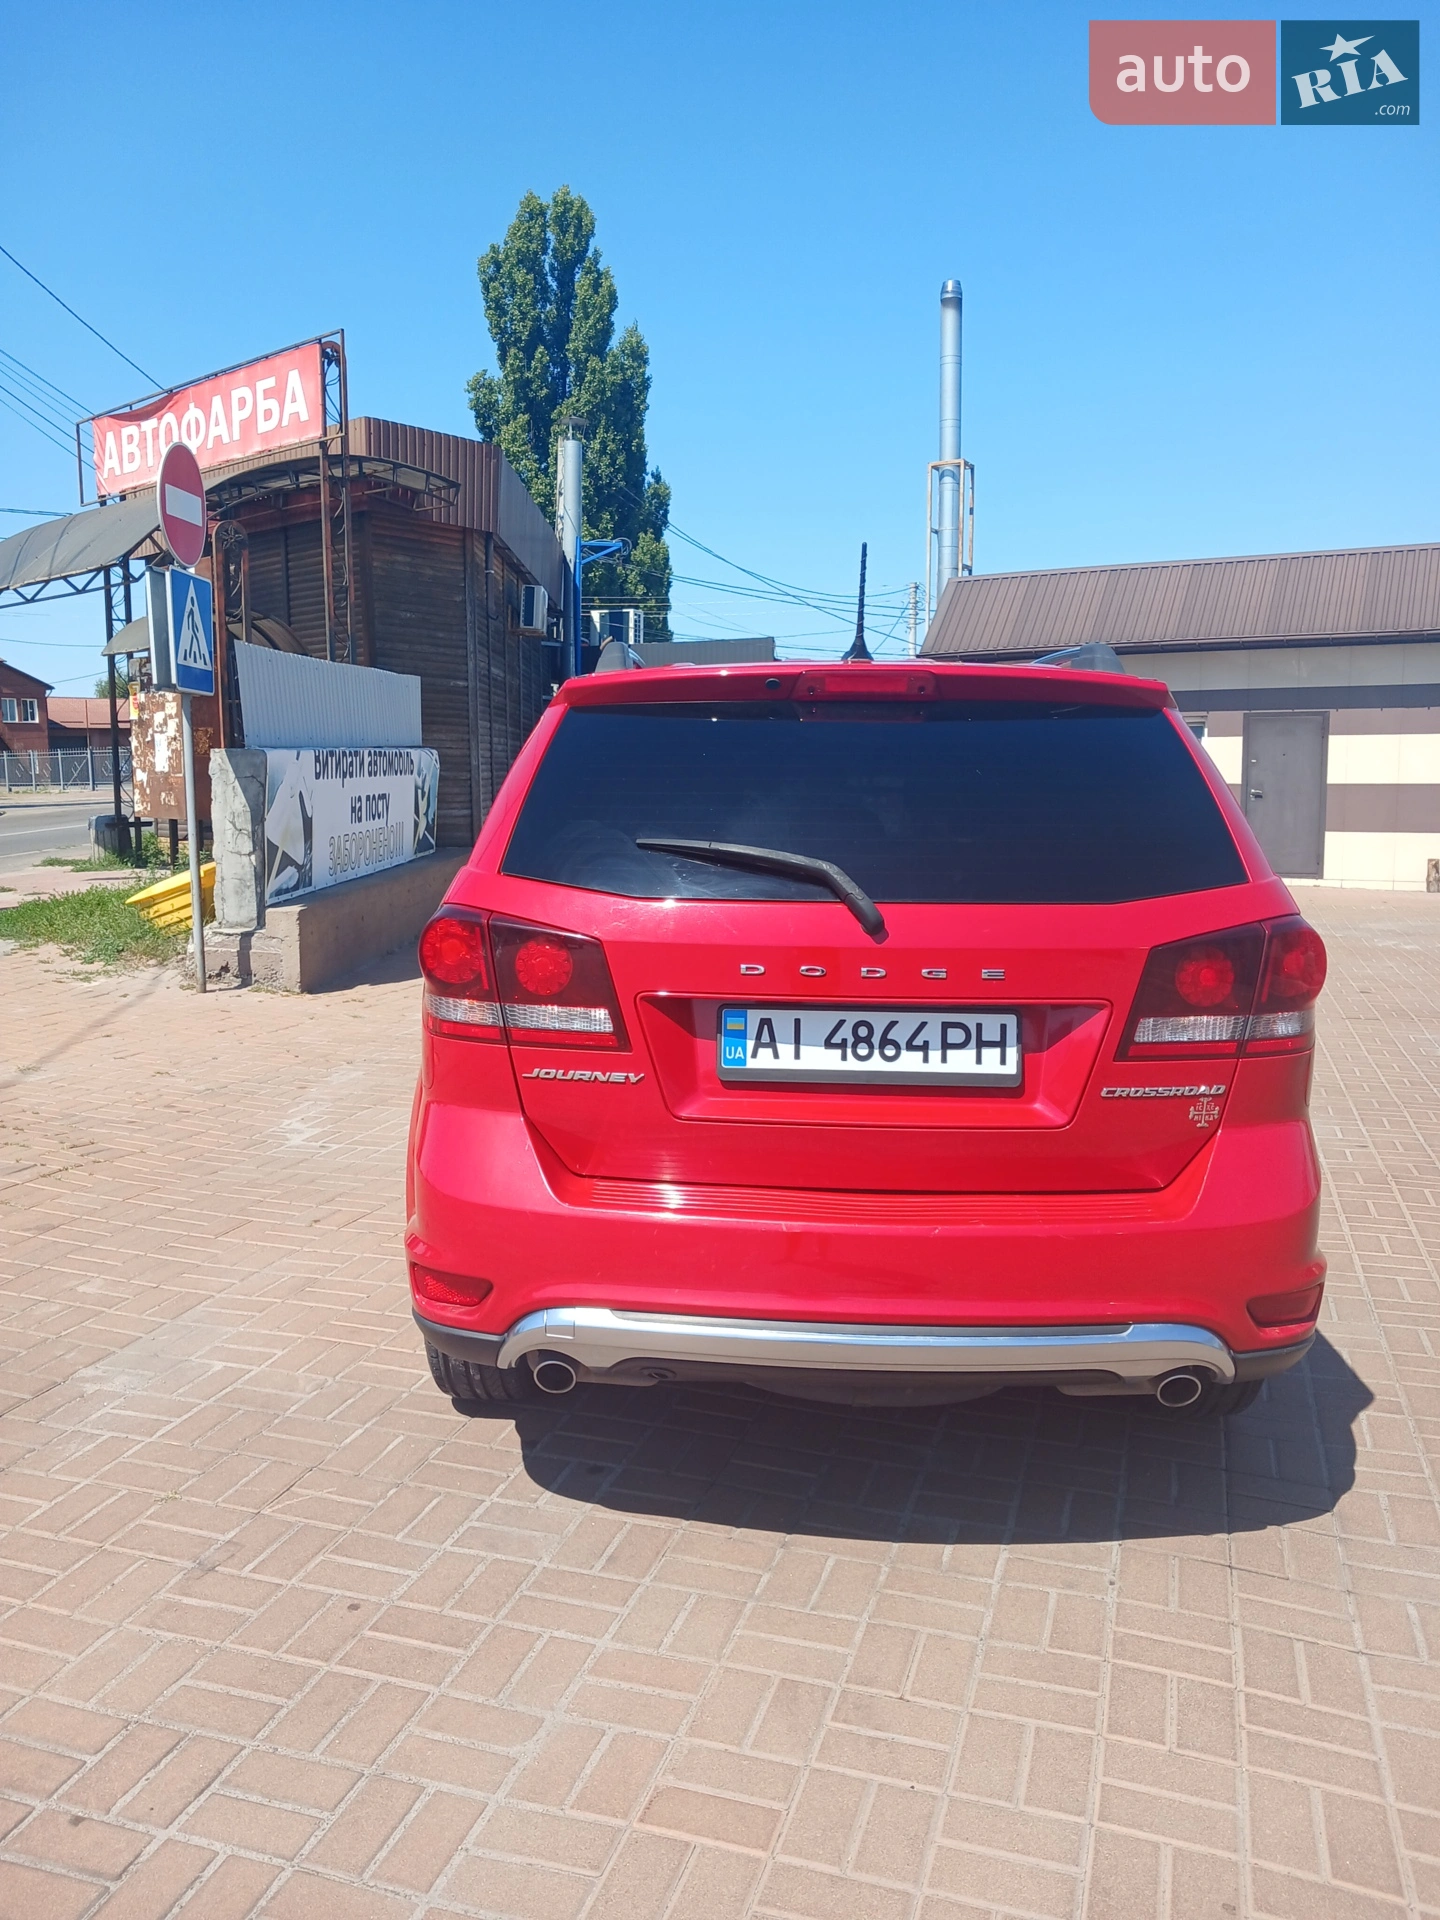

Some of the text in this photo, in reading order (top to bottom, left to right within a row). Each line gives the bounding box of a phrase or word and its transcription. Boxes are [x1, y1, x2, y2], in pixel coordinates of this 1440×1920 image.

[103, 368, 310, 479] АВТОФАРБА
[314, 749, 365, 788] Витирати
[350, 792, 391, 826] на посту
[328, 821, 404, 877] ЗАБОРОНЕНО!!!
[740, 963, 1006, 980] DODGE
[725, 1045, 745, 1060] UA
[521, 1068, 645, 1083] JOURNEY
[1100, 1085, 1226, 1098] CROSSROAD
